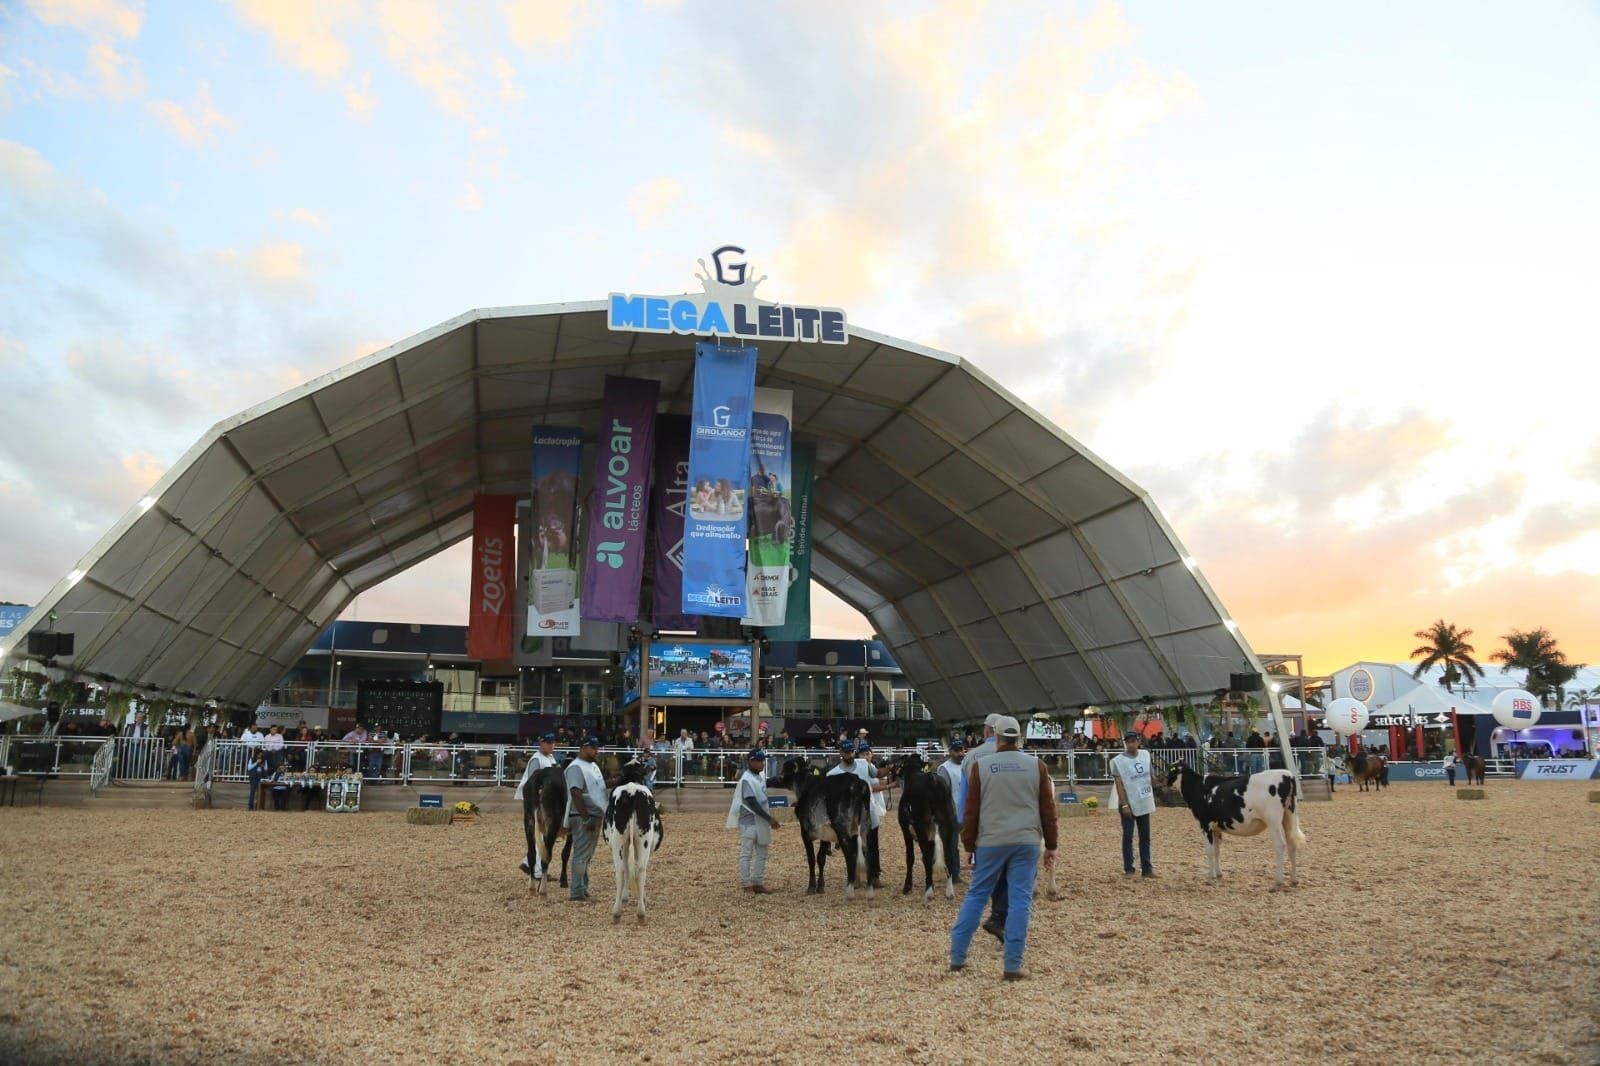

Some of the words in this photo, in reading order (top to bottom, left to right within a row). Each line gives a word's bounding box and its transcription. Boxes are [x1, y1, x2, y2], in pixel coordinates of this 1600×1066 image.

[712, 246, 747, 286] G
[713, 406, 730, 427] G
[696, 428, 745, 437] GIROLANDO
[533, 436, 580, 447] Lactotropin
[665, 461, 689, 518] Alta
[628, 485, 643, 531] lácteos
[479, 536, 506, 615] zoetis
[1512, 700, 1532, 710] ABS
[1375, 716, 1404, 726] SELECT
[1404, 715, 1429, 725] SRES
[1537, 765, 1577, 773] TRUST
